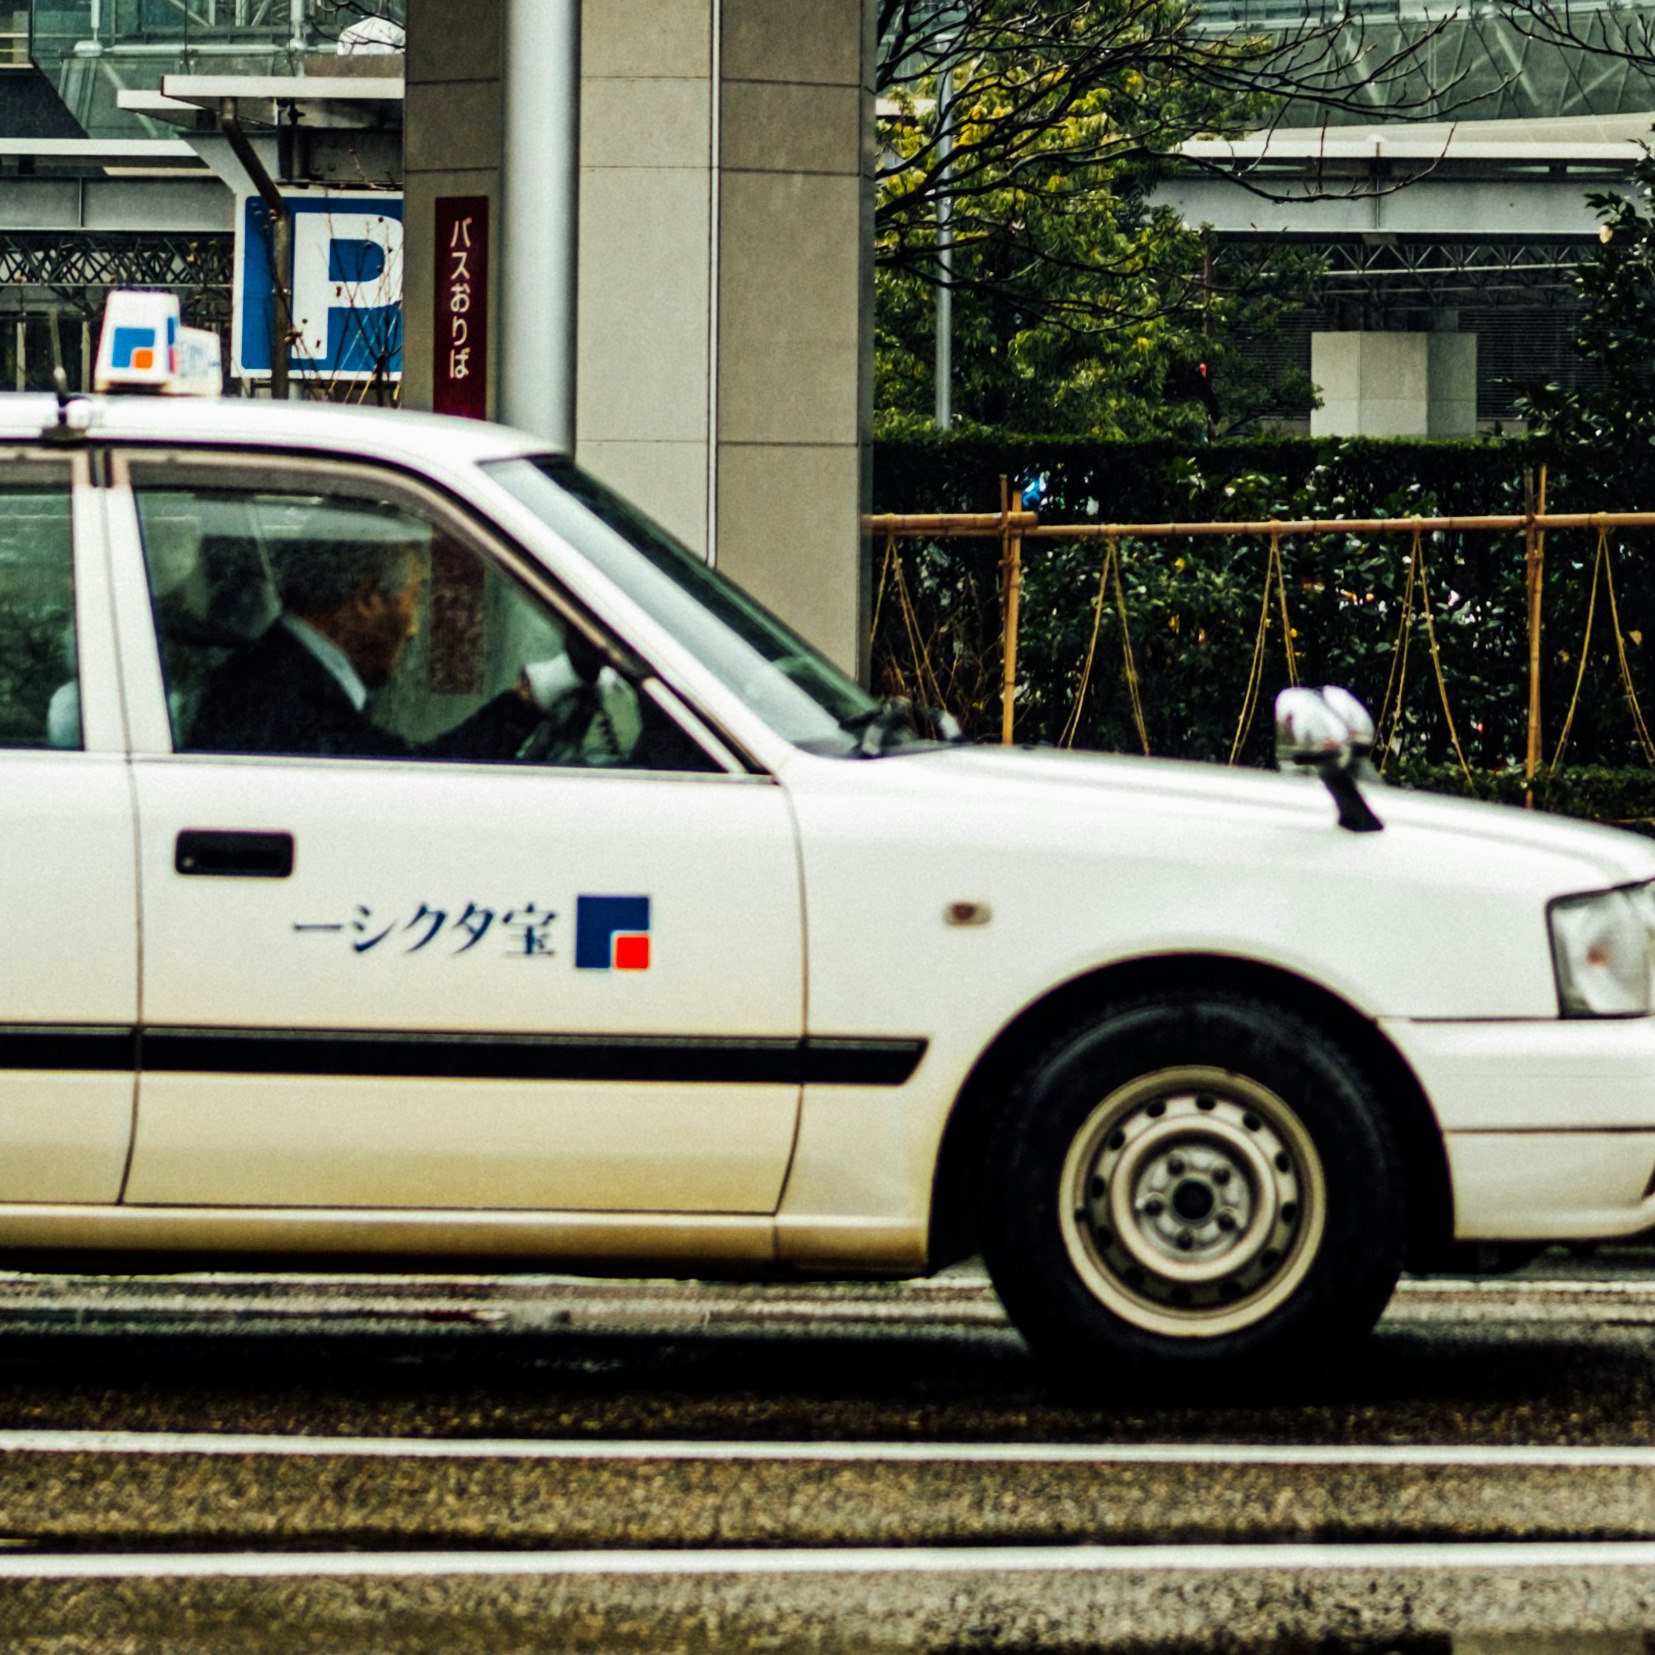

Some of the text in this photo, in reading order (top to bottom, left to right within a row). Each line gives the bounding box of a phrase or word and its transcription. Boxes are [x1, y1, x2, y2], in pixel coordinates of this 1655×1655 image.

[291, 212, 404, 360] P
[450, 216, 473, 380] バスおりば
